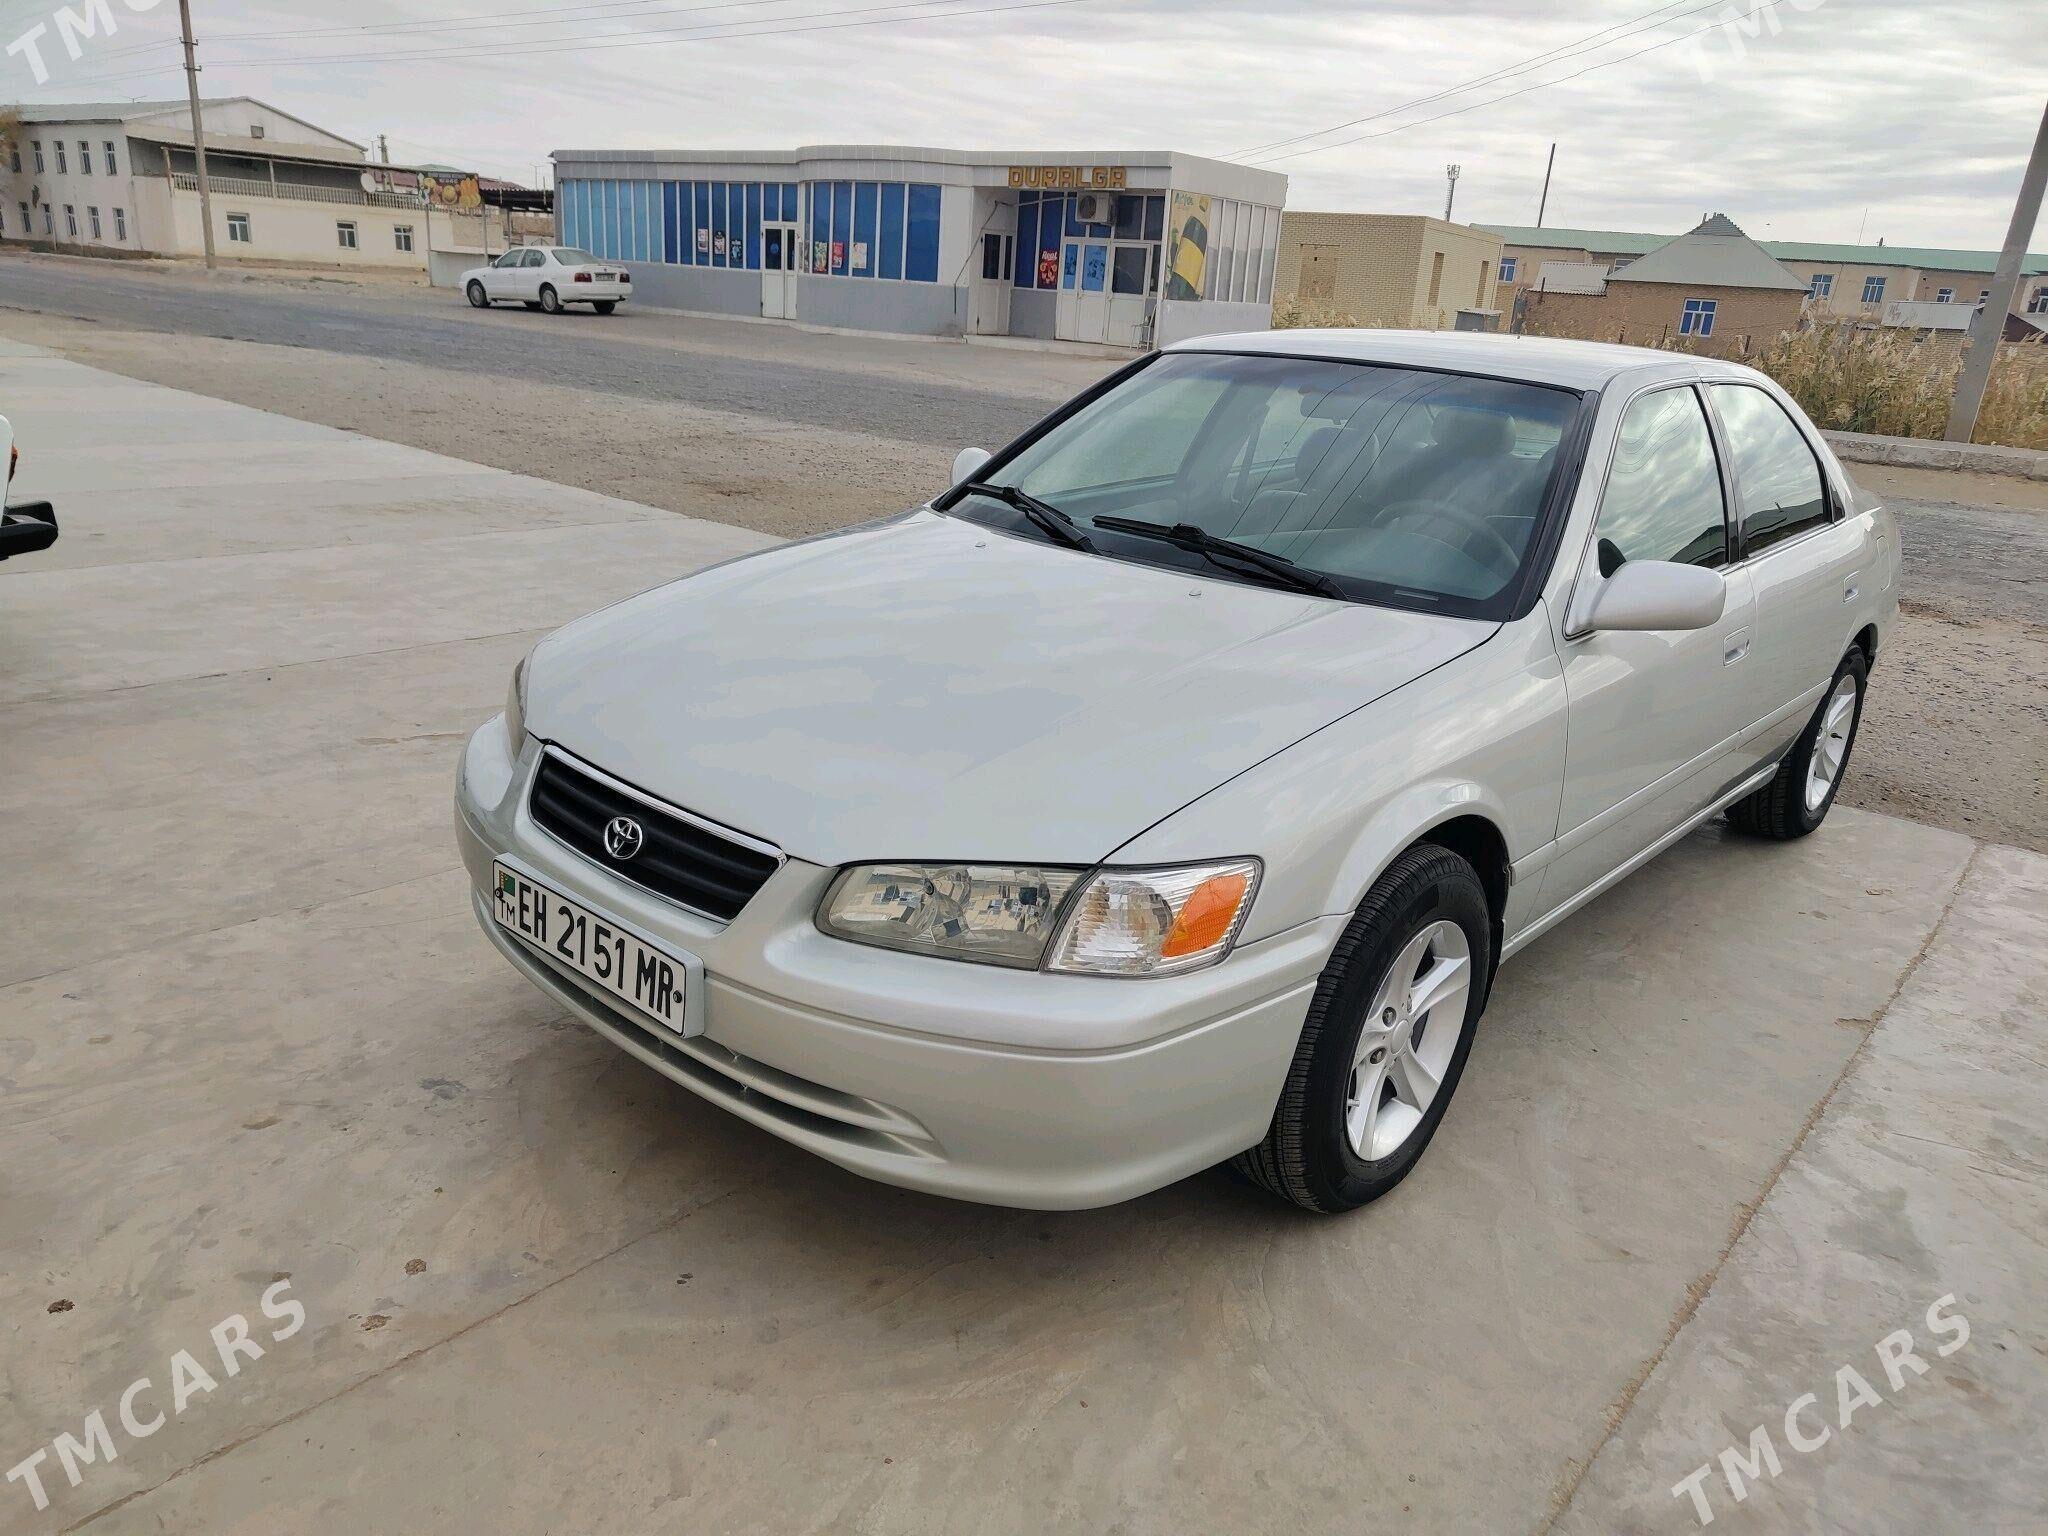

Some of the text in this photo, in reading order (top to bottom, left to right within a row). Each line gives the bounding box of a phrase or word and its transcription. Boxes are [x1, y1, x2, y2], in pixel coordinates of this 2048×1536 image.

[1008, 165, 1127, 188] DURALGA
[500, 898, 515, 926] TM
[518, 881, 675, 1020] EH 2151 MR
